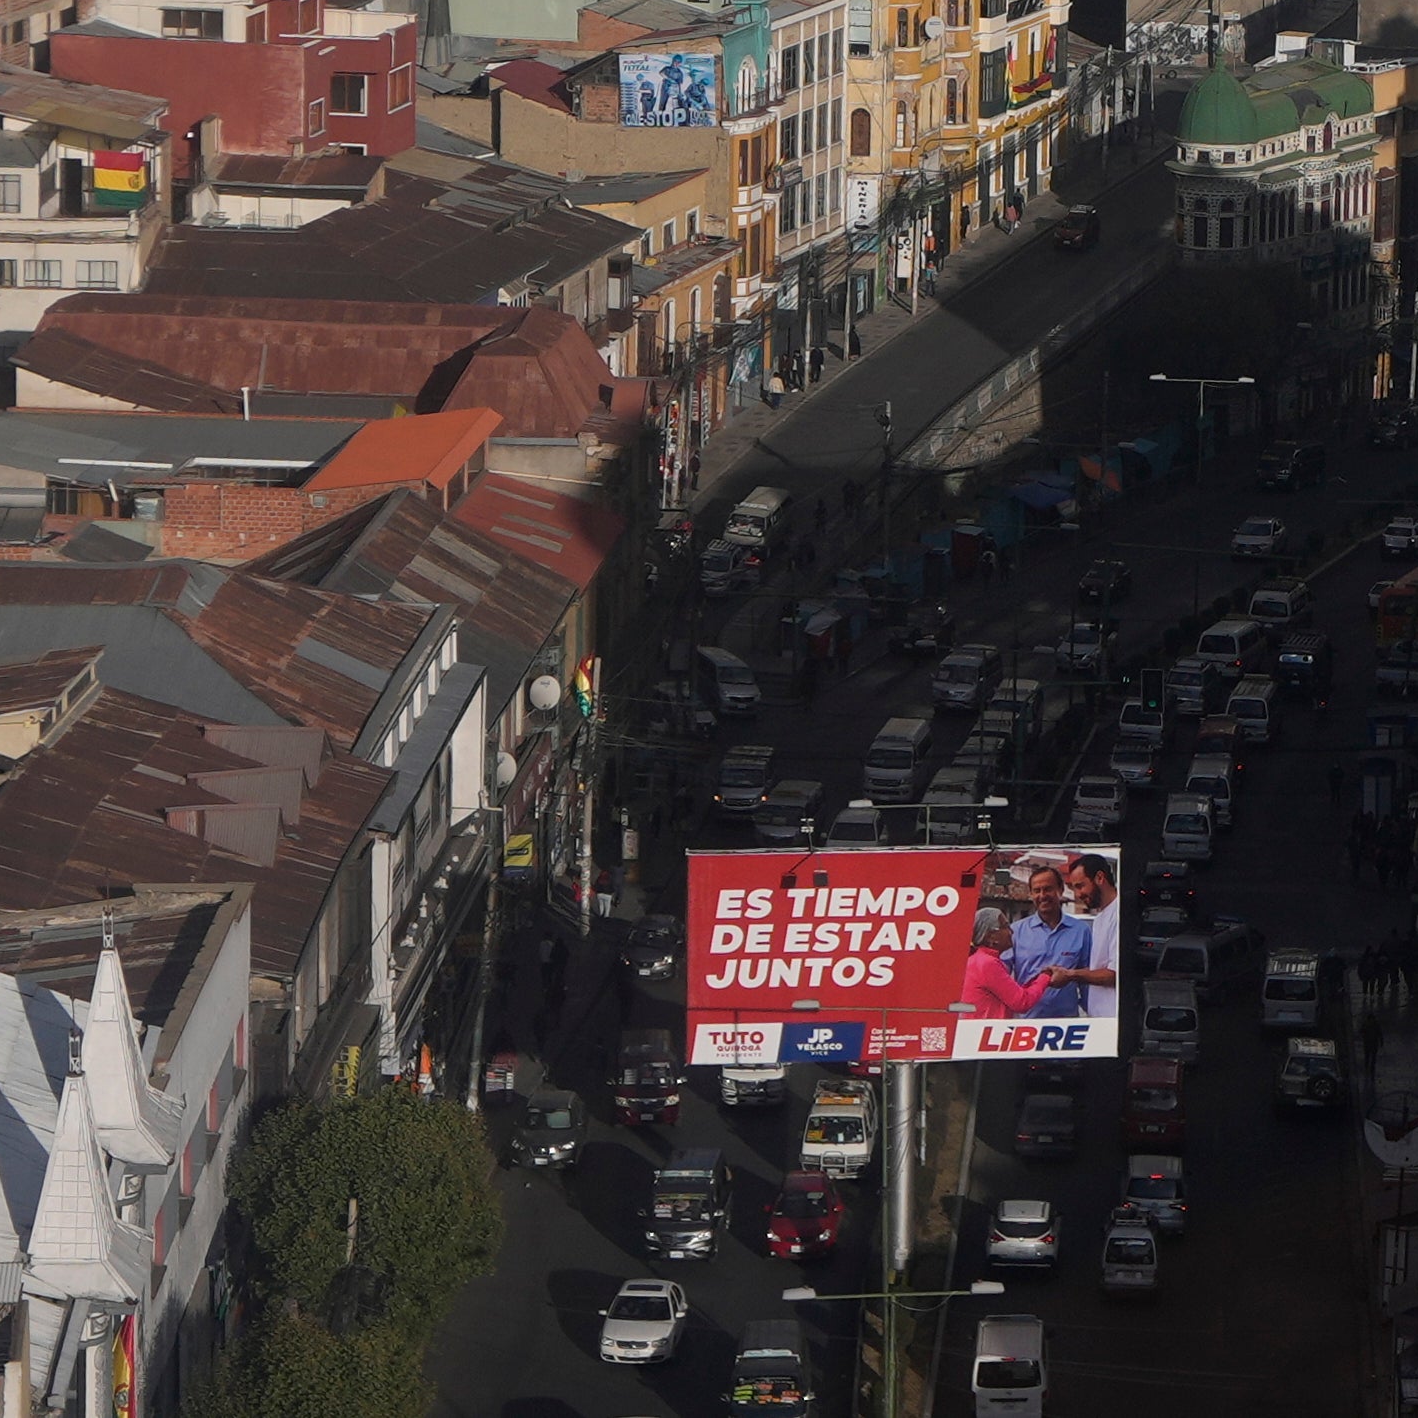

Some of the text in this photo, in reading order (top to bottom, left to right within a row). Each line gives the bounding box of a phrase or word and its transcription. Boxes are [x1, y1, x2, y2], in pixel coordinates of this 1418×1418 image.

[715, 886, 960, 919] ES TIEMPO
[709, 922, 936, 955] DE ESTAR
[706, 957, 895, 990] JUNTOS
[708, 1031, 764, 1045] TUTO
[796, 1043, 843, 1052] VELASCO
[807, 1028, 833, 1043] JP
